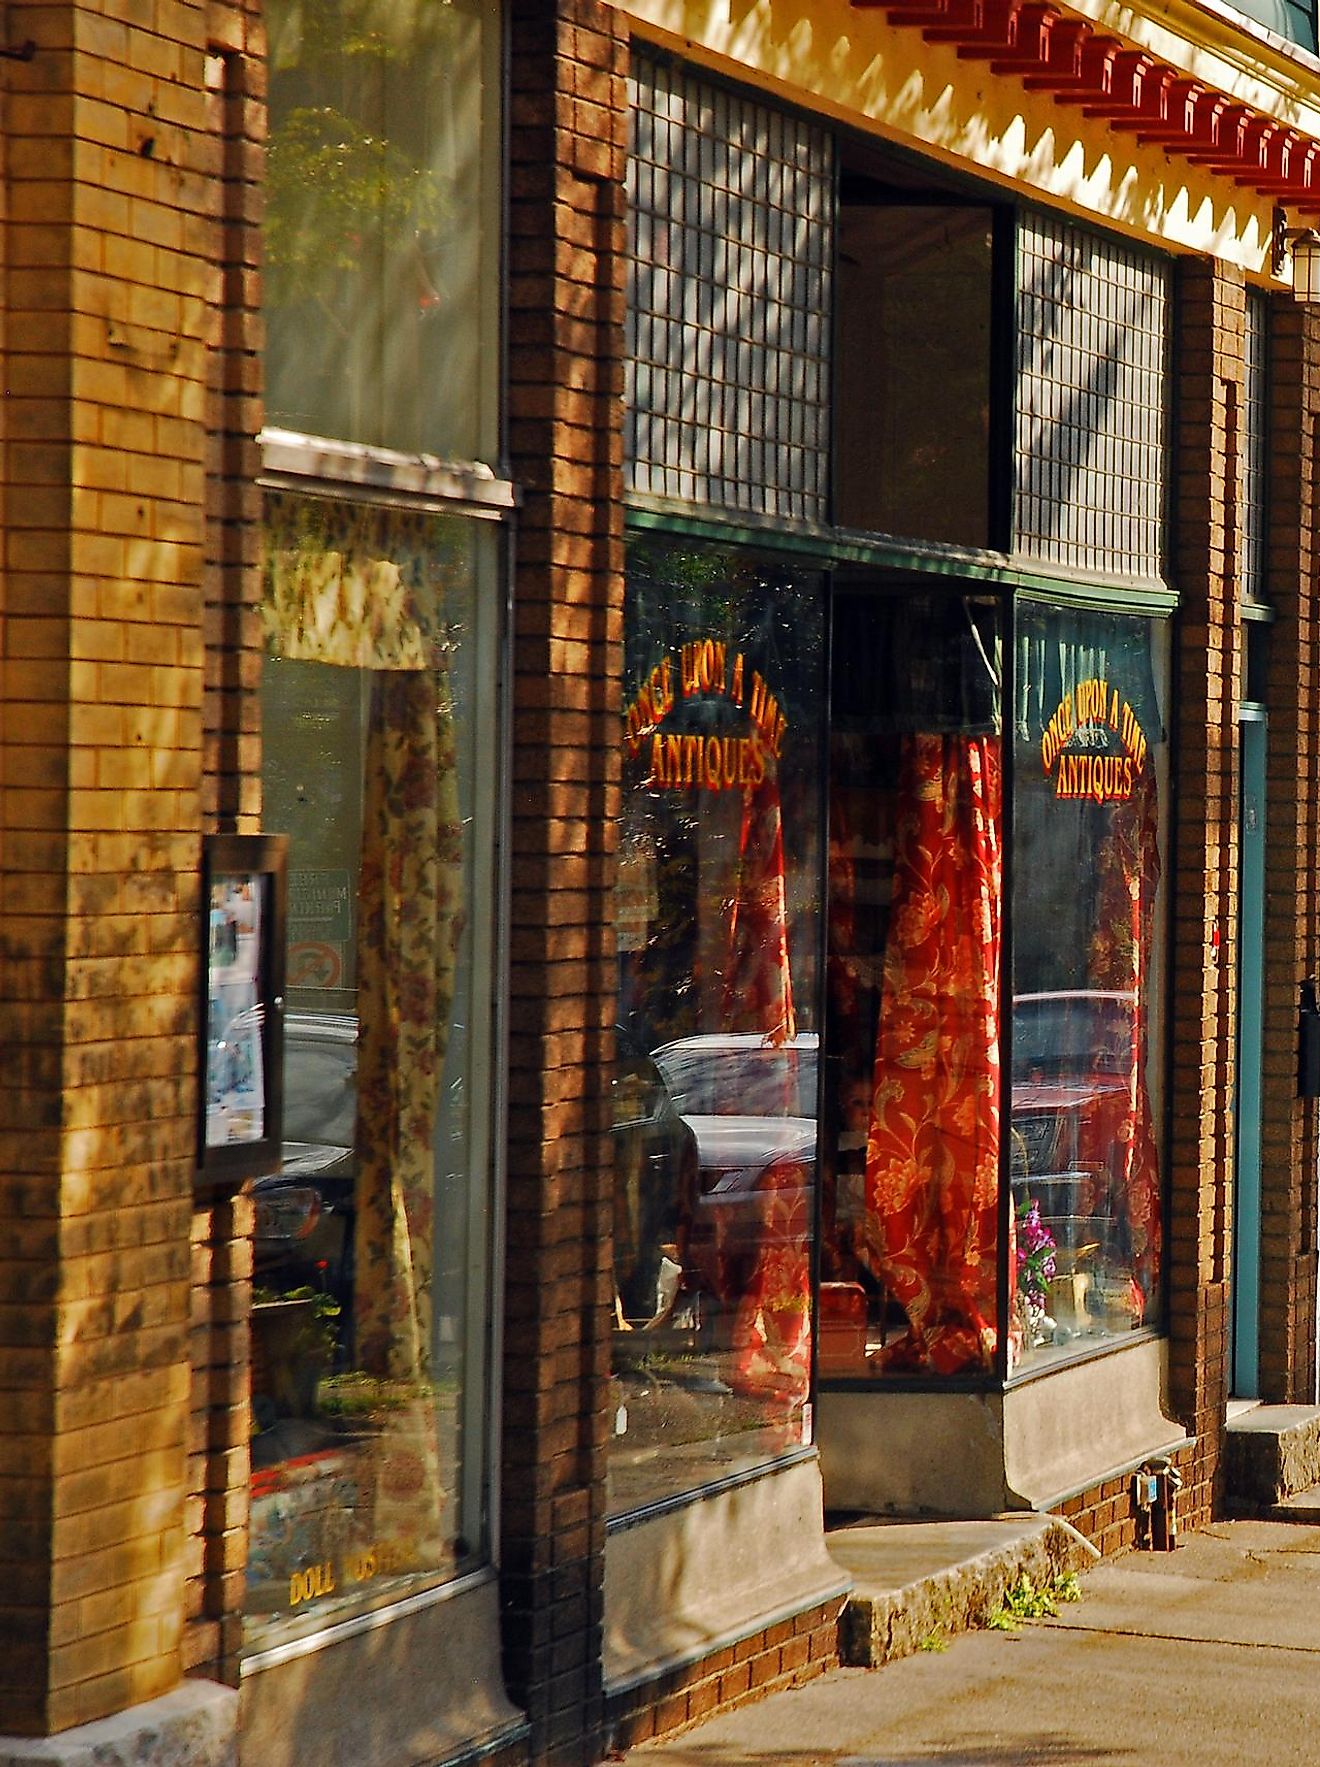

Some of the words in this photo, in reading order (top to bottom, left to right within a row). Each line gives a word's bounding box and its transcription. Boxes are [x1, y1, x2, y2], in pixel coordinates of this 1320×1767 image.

[730, 652, 745, 706] A
[1042, 691, 1074, 778] ONCE
[1075, 678, 1109, 729] UPON
[1109, 689, 1119, 733] A
[1122, 701, 1148, 776] TIME
[650, 733, 766, 793] ANTIQUES
[1055, 755, 1134, 805] ANTIQUES
[289, 1562, 336, 1607] DOLL
